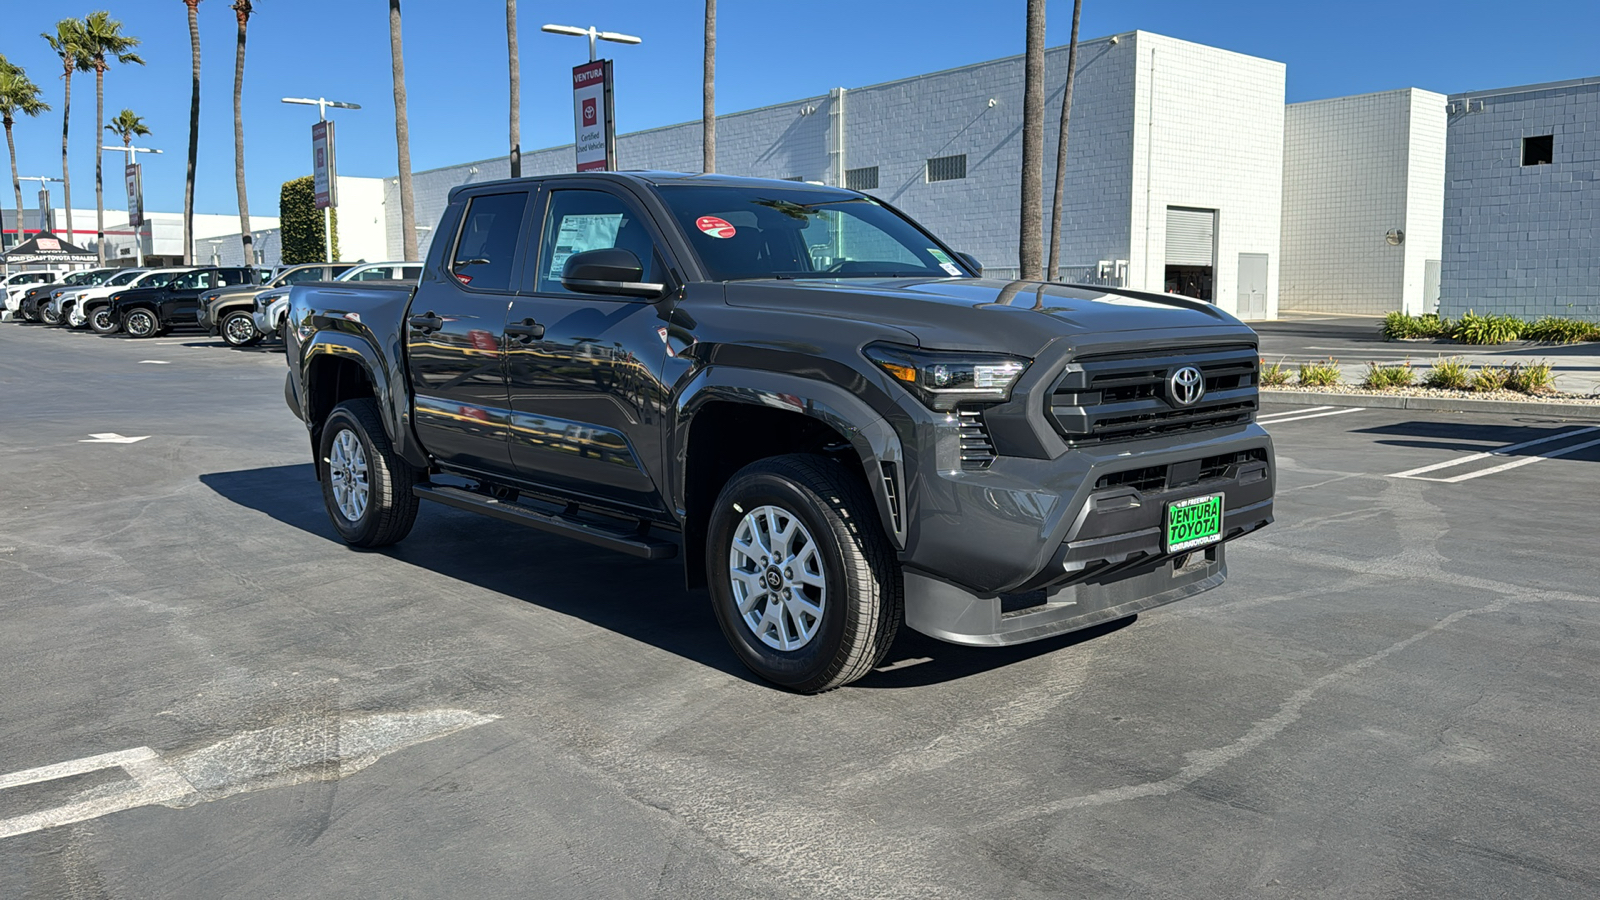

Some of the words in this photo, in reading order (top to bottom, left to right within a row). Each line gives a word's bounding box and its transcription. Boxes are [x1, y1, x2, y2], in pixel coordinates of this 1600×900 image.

[574, 68, 603, 82] VENTURA
[581, 131, 600, 142] Certified
[577, 143, 588, 153] Used
[588, 141, 605, 152] Vehicles
[1170, 502, 1217, 525] VENTURA
[1171, 518, 1215, 540] TOYOTA
